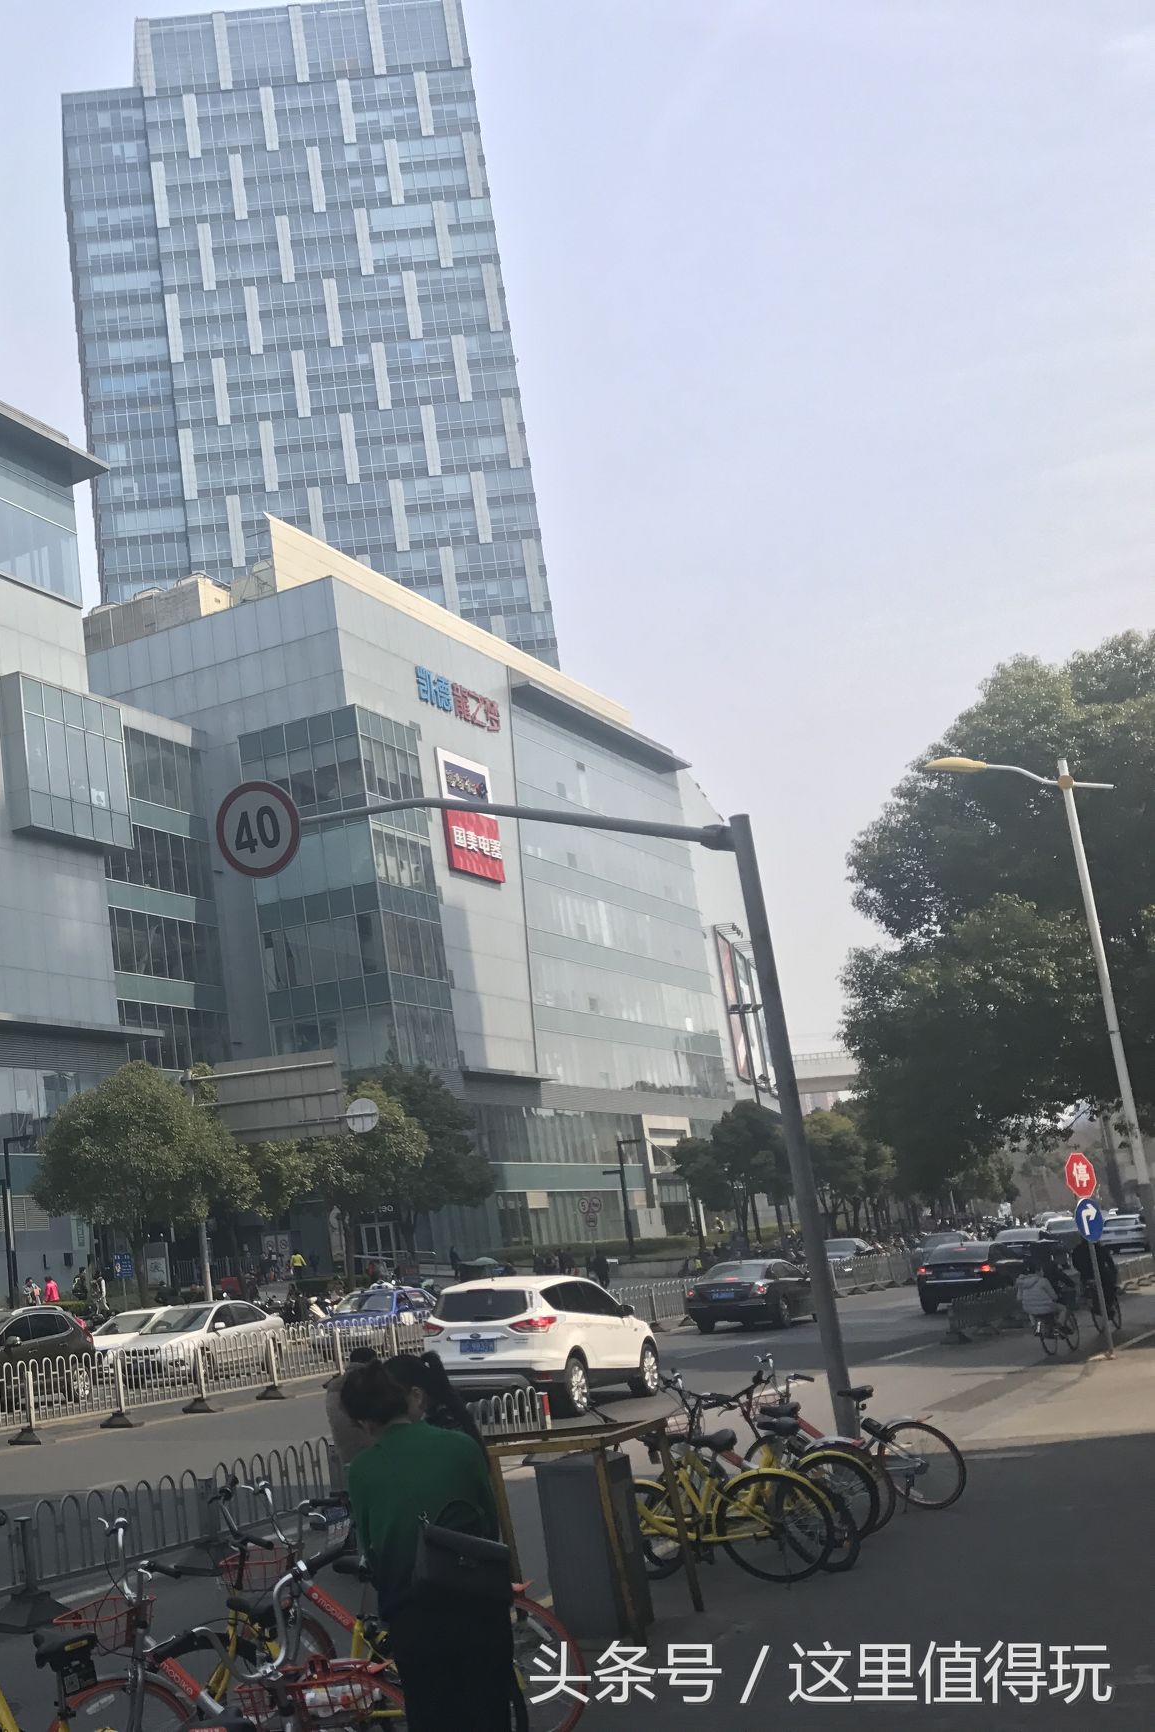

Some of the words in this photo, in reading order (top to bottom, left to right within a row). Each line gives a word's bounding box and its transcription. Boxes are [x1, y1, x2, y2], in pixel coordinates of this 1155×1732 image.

[234, 805, 281, 854] 40
[451, 825, 503, 860] 国美电器
[1072, 1161, 1090, 1188] 停
